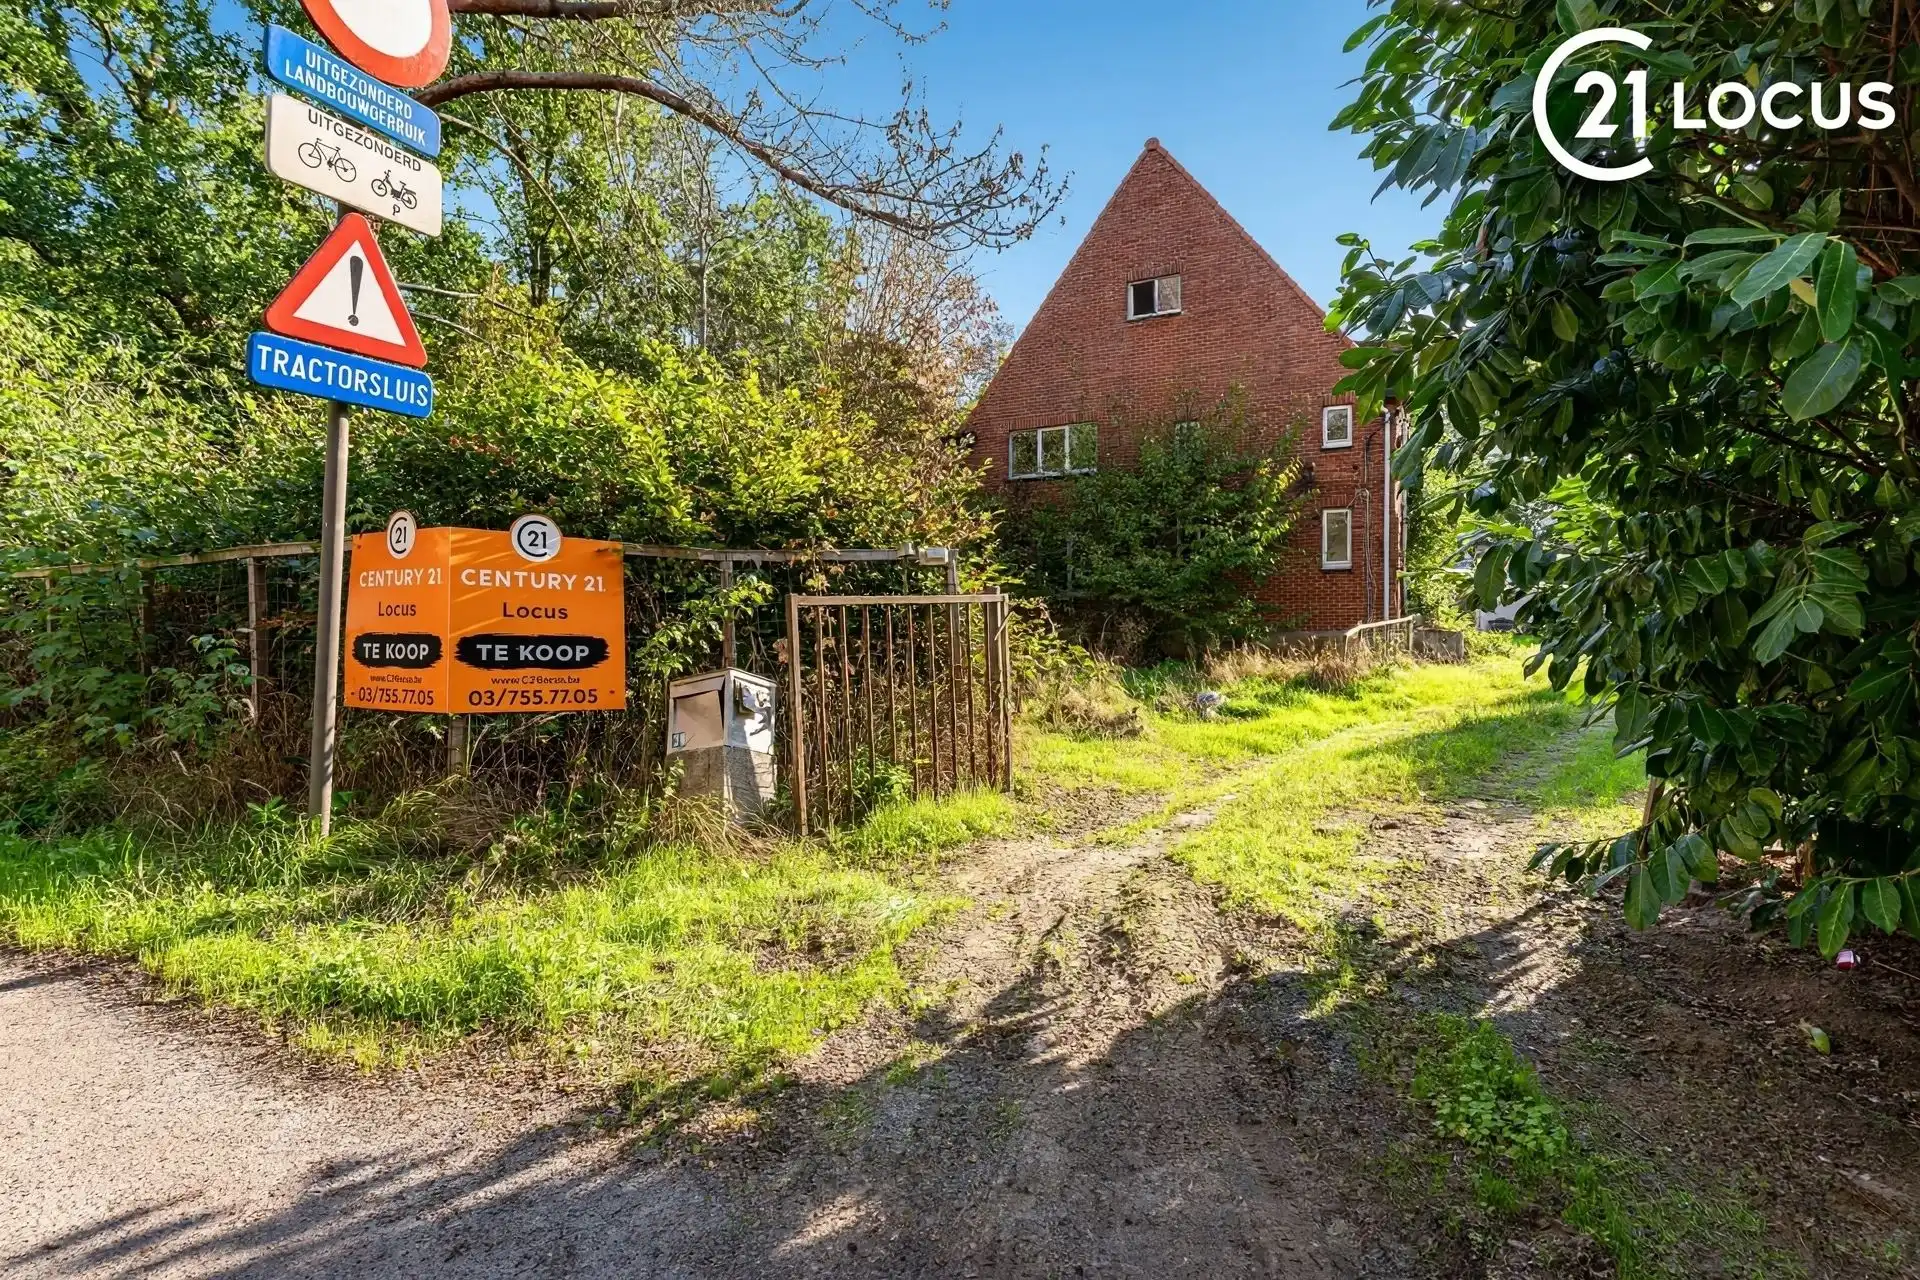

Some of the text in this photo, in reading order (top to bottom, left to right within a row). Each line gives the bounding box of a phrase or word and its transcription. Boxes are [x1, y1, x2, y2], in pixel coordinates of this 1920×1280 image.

[305, 49, 412, 119] UITGEZONDERD
[308, 109, 421, 172] UITGEZONDERD
[257, 344, 429, 407] TRACTORSLUIS
[359, 568, 424, 587] CENTURY
[460, 568, 578, 591] CENTURY
[363, 643, 429, 660] TE KOOP
[476, 644, 590, 662] TE KOOP
[358, 686, 434, 706] 03/755.77.05
[468, 688, 598, 707] 03/755.77.05
